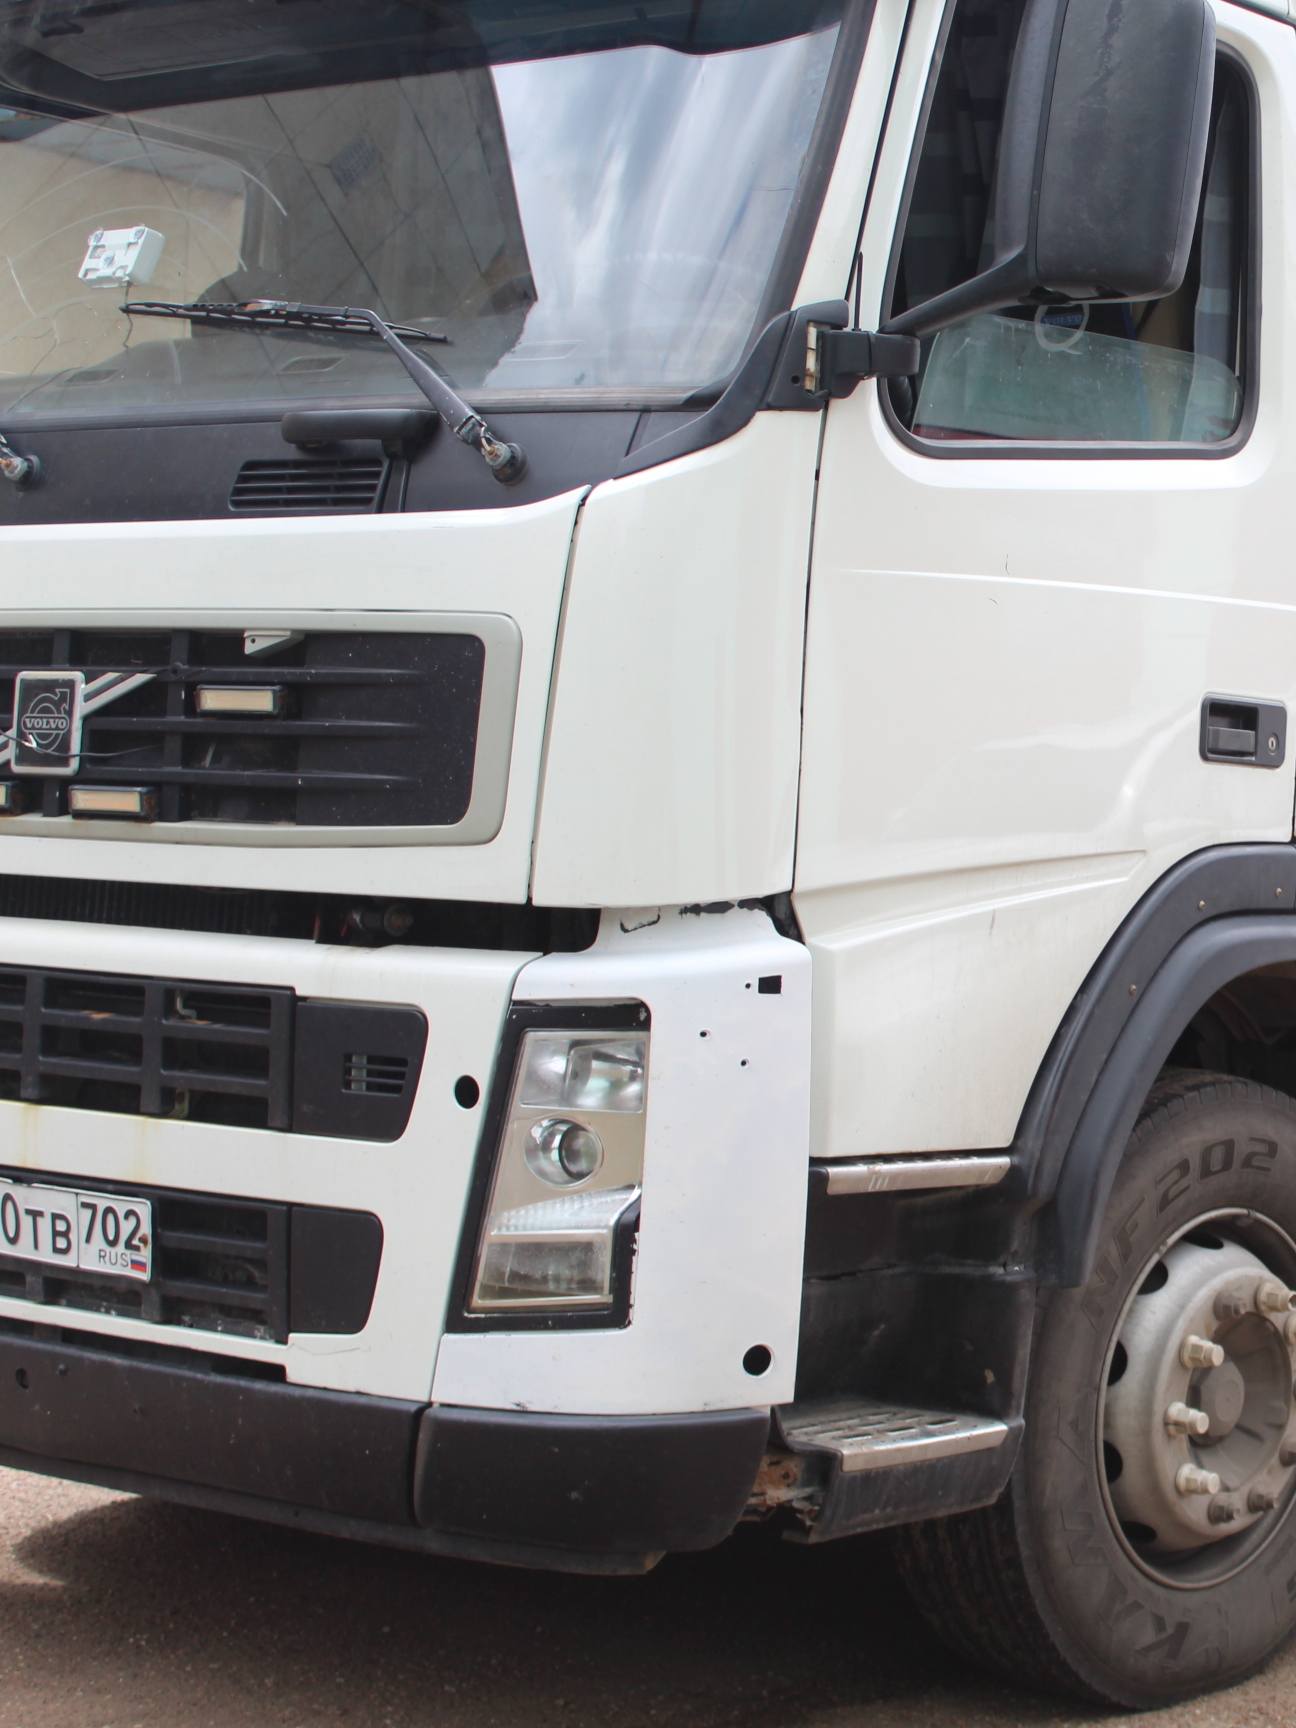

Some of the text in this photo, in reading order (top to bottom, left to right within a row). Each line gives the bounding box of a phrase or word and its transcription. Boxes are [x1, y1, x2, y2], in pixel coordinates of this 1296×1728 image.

[24, 717, 67, 729] VOLVO
[80, 1201, 141, 1253] 702
[98, 1249, 130, 1268] RUS
